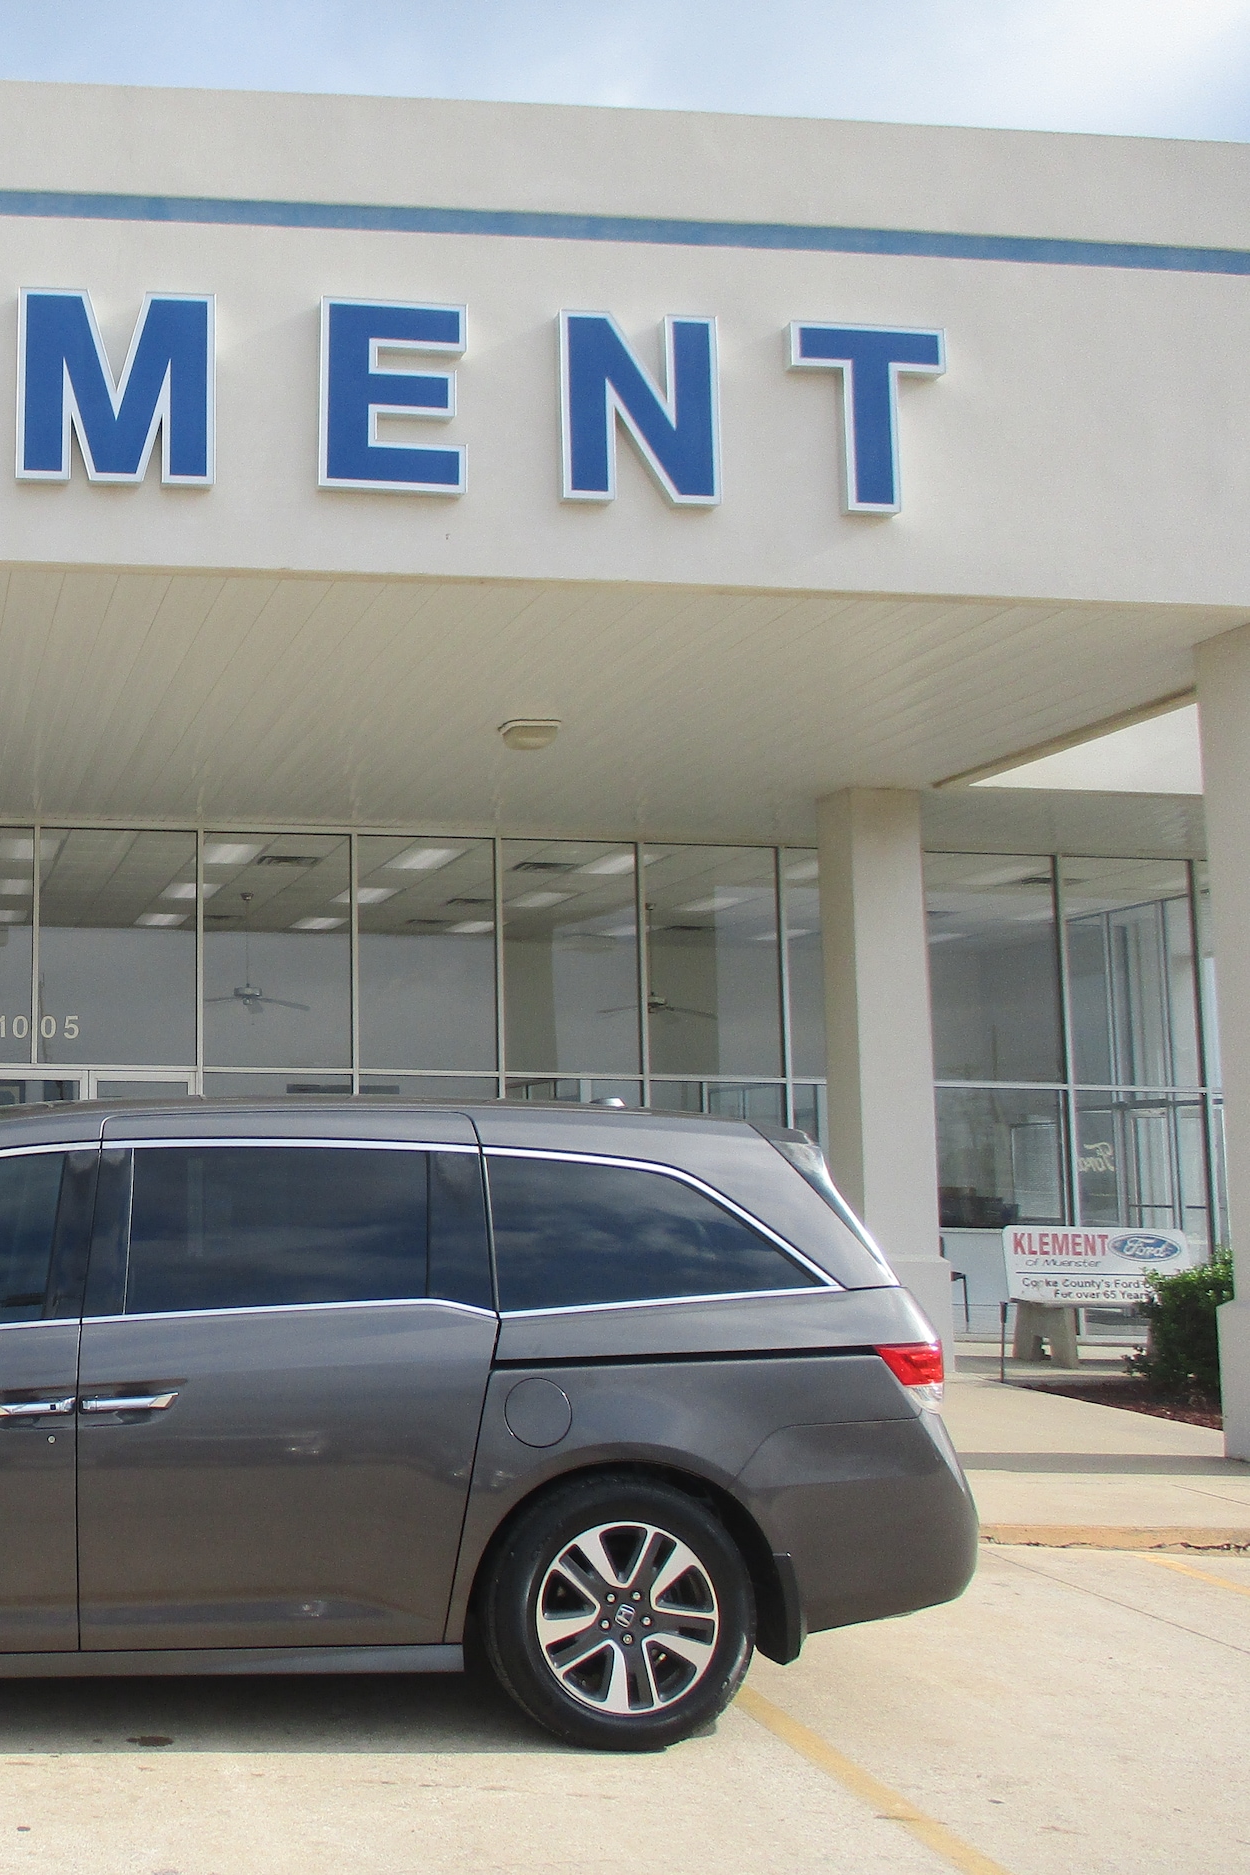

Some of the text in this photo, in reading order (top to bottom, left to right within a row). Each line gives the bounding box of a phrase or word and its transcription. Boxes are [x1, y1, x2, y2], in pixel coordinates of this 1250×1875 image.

[1012, 1232, 1171, 1258] KLEMENT Ford
[1044, 1259, 1102, 1268] Muenster
[1022, 1277, 1058, 1287] Coke
[1061, 1278, 1111, 1290] County's
[1114, 1279, 1140, 1289] Ford
[1076, 1291, 1100, 1299] over
[1102, 1290, 1117, 1299] 65
[1119, 1290, 1149, 1300] Year
